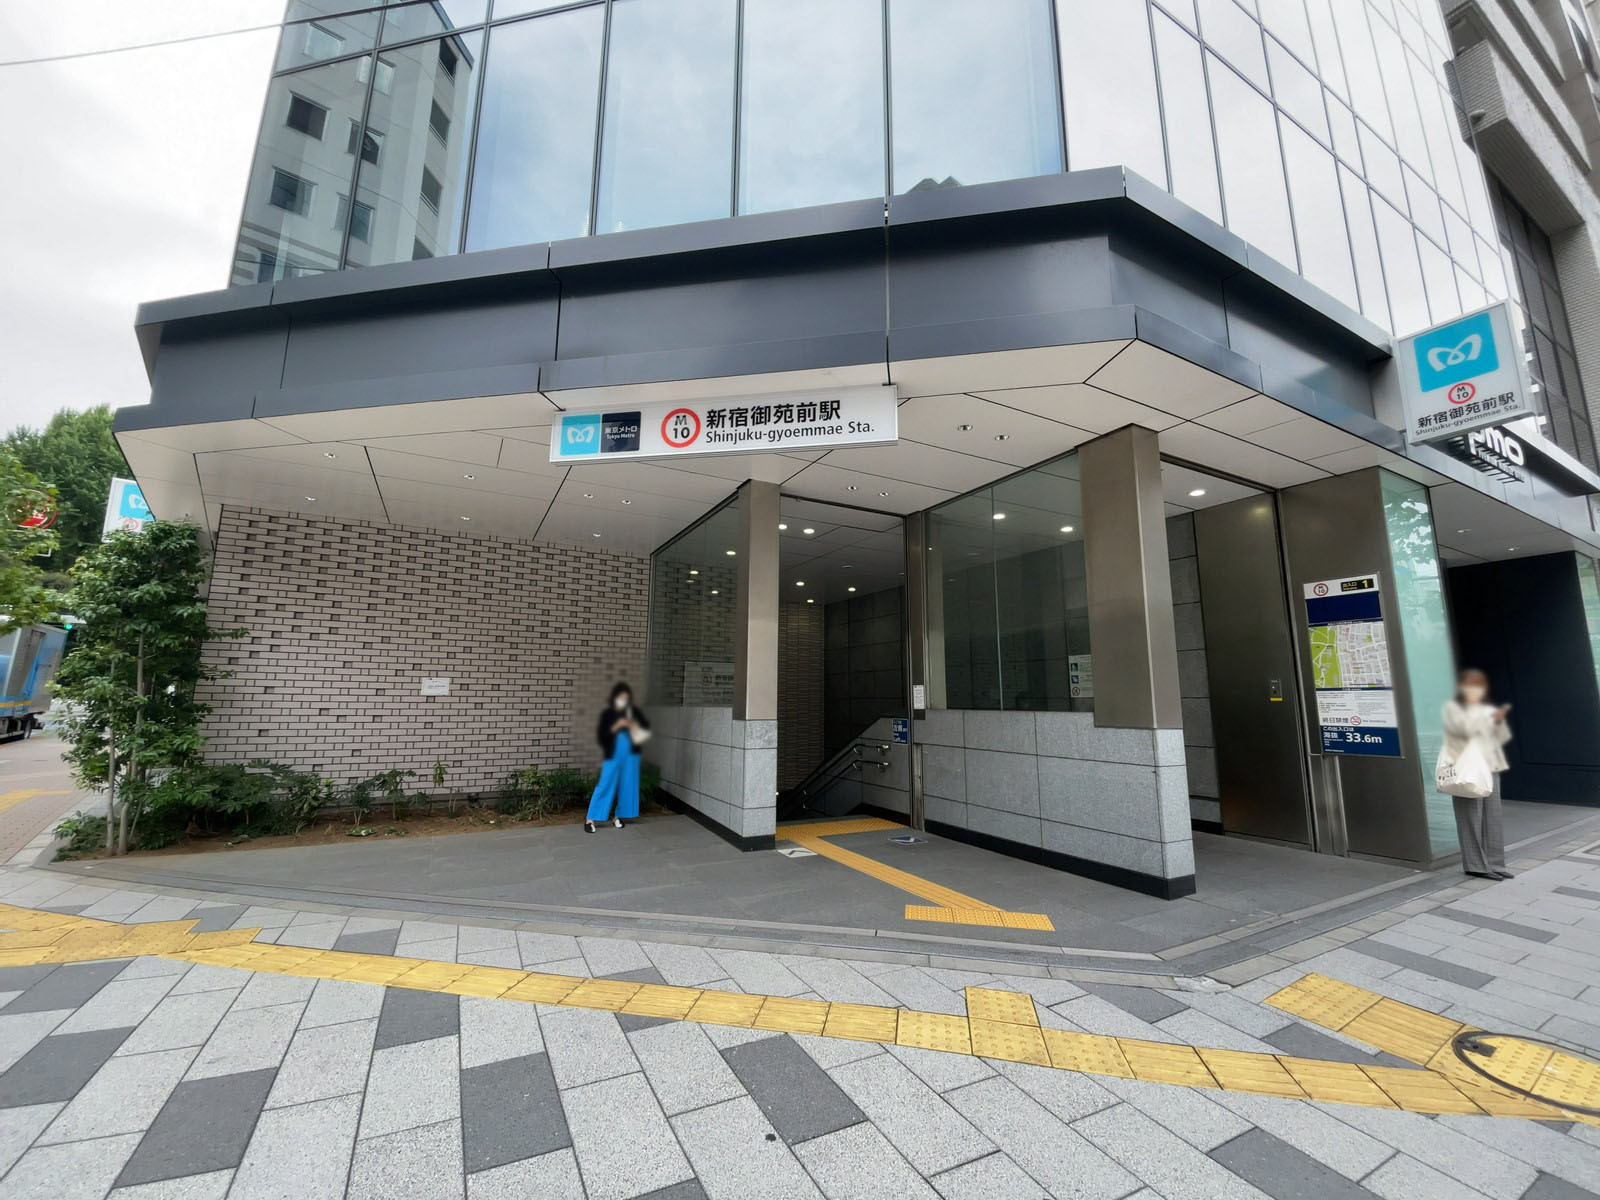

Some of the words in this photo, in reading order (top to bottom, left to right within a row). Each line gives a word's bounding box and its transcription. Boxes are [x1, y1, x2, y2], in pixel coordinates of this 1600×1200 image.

[1457, 391, 1469, 400] 10
[706, 399, 841, 430] 新宿御苑前駅
[1417, 392, 1515, 428] 新宿御苑前駅
[674, 415, 688, 426] M
[1415, 409, 1502, 436] Shinjuku-gyoemmae
[1504, 404, 1521, 412] Sta.
[604, 425, 638, 433] 東京メトロ
[672, 427, 690, 440] 10
[706, 422, 843, 444] Shinjuku-gyoemmae
[848, 420, 875, 434] Sta.
[1362, 580, 1368, 588] 1
[1346, 732, 1382, 744] 33.6m
